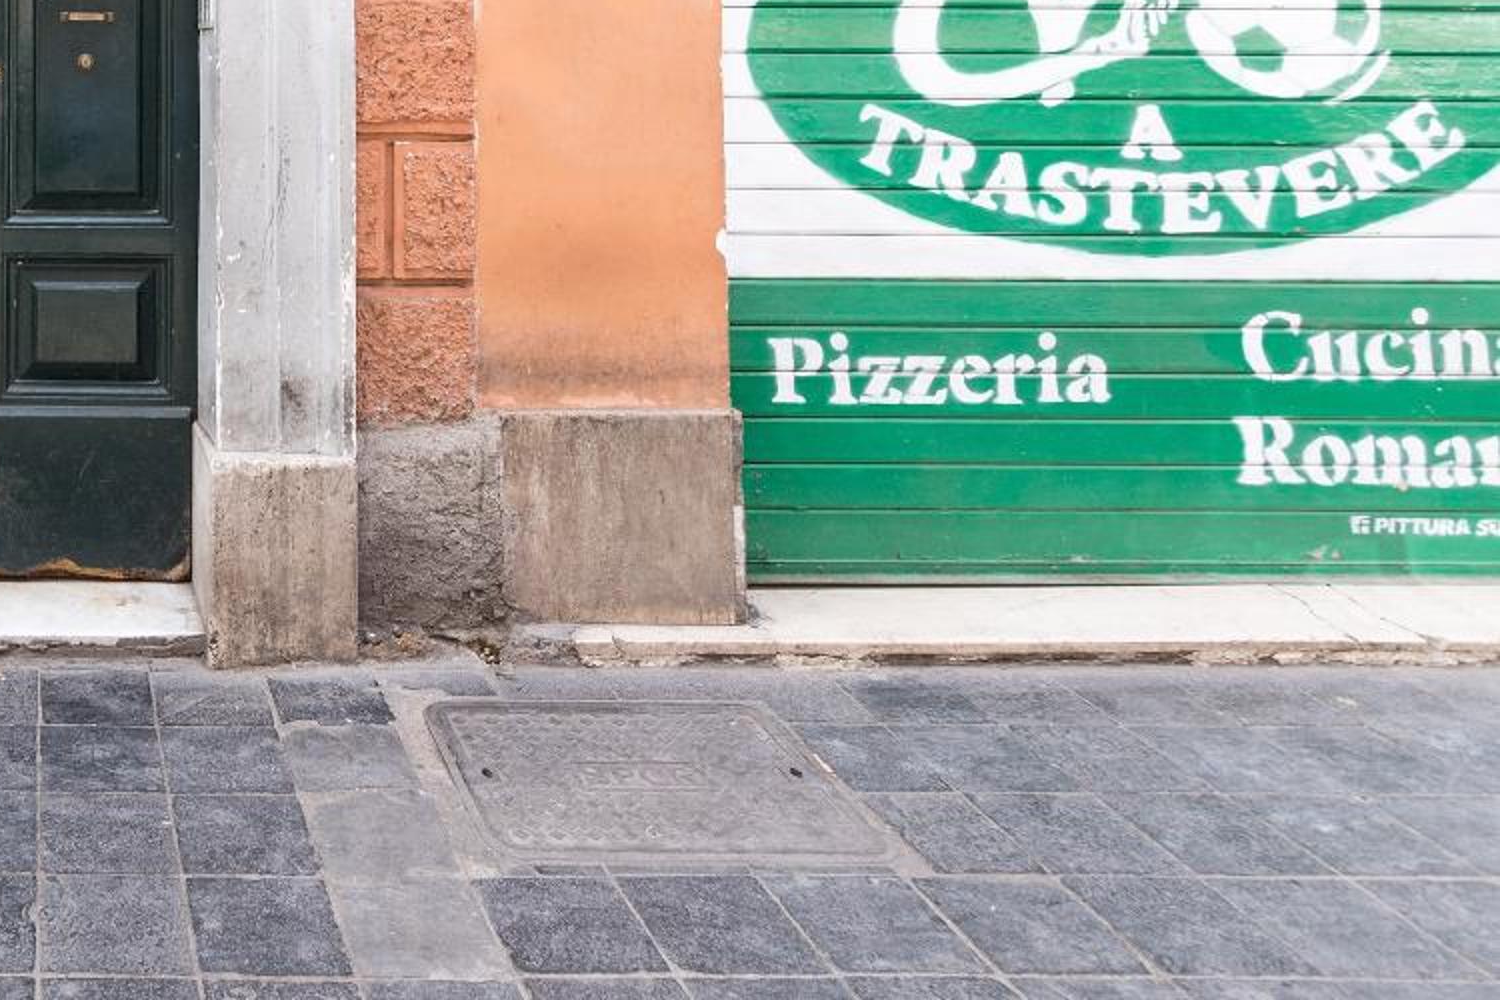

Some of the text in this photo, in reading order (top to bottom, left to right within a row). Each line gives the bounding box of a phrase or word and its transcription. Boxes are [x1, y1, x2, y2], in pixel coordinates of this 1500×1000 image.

[859, 101, 1465, 234] TRASTEVERE
[1120, 104, 1183, 161] A
[766, 331, 1112, 404] Pizzeria
[1241, 307, 1500, 383] Cucin
[1373, 517, 1471, 537] PITTURA
